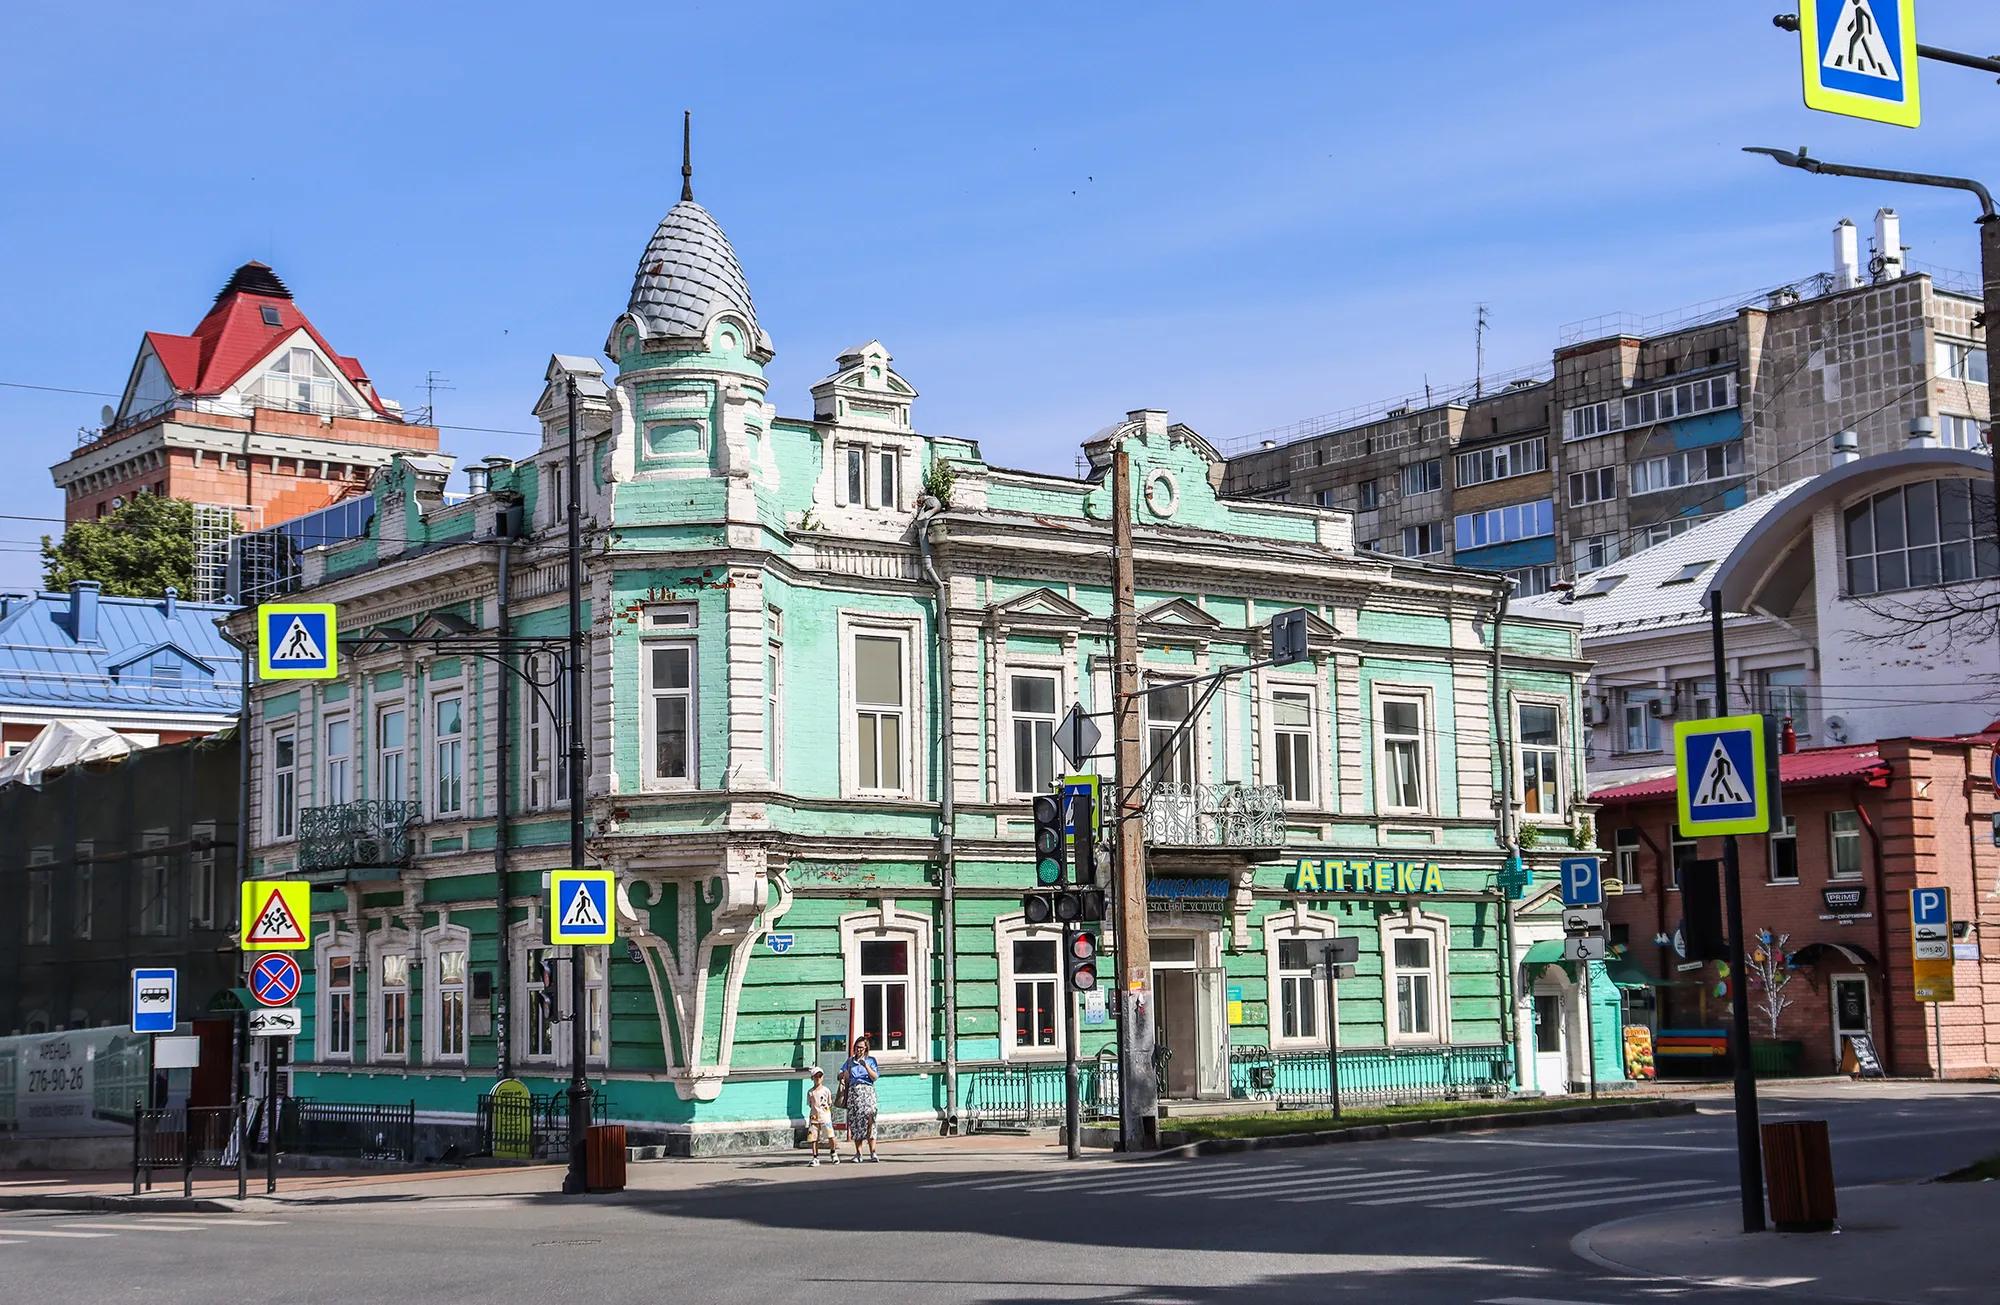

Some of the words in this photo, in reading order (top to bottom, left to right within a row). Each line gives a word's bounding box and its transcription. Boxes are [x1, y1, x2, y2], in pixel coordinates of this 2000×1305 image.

[1295, 858, 1445, 893] АПТЕКА
[1570, 863, 1592, 900] P
[1146, 879, 1230, 900] АНЦЕЛЯРИЯ
[1920, 892, 1940, 919] P
[777, 943, 785, 951] 17
[28, 1066, 83, 1093] 276-90-26
